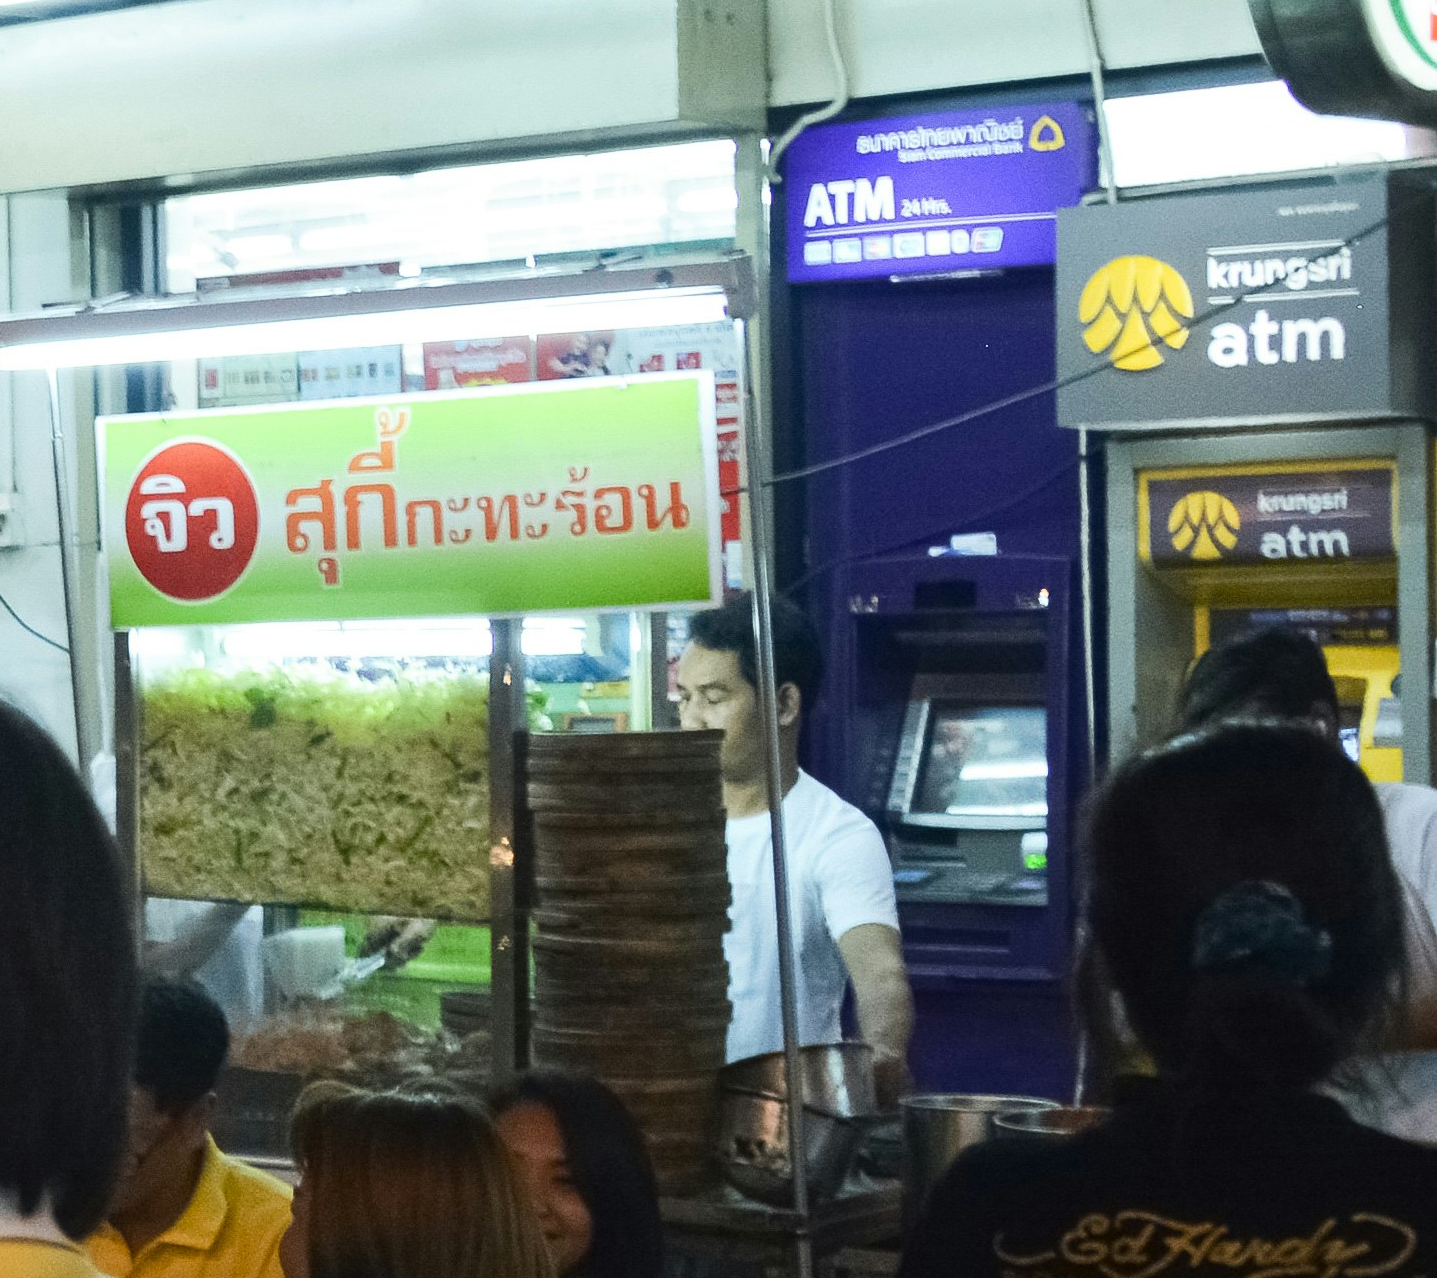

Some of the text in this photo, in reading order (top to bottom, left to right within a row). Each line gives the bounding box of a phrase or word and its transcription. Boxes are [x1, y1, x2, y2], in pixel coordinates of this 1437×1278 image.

[804, 175, 896, 227] ATM
[900, 198, 920, 218] 24
[1206, 246, 1352, 291] krungsri
[1206, 309, 1346, 368] atm
[139, 473, 237, 553] จิว
[1256, 486, 1349, 516] krungsri
[1258, 523, 1350, 561] atm
